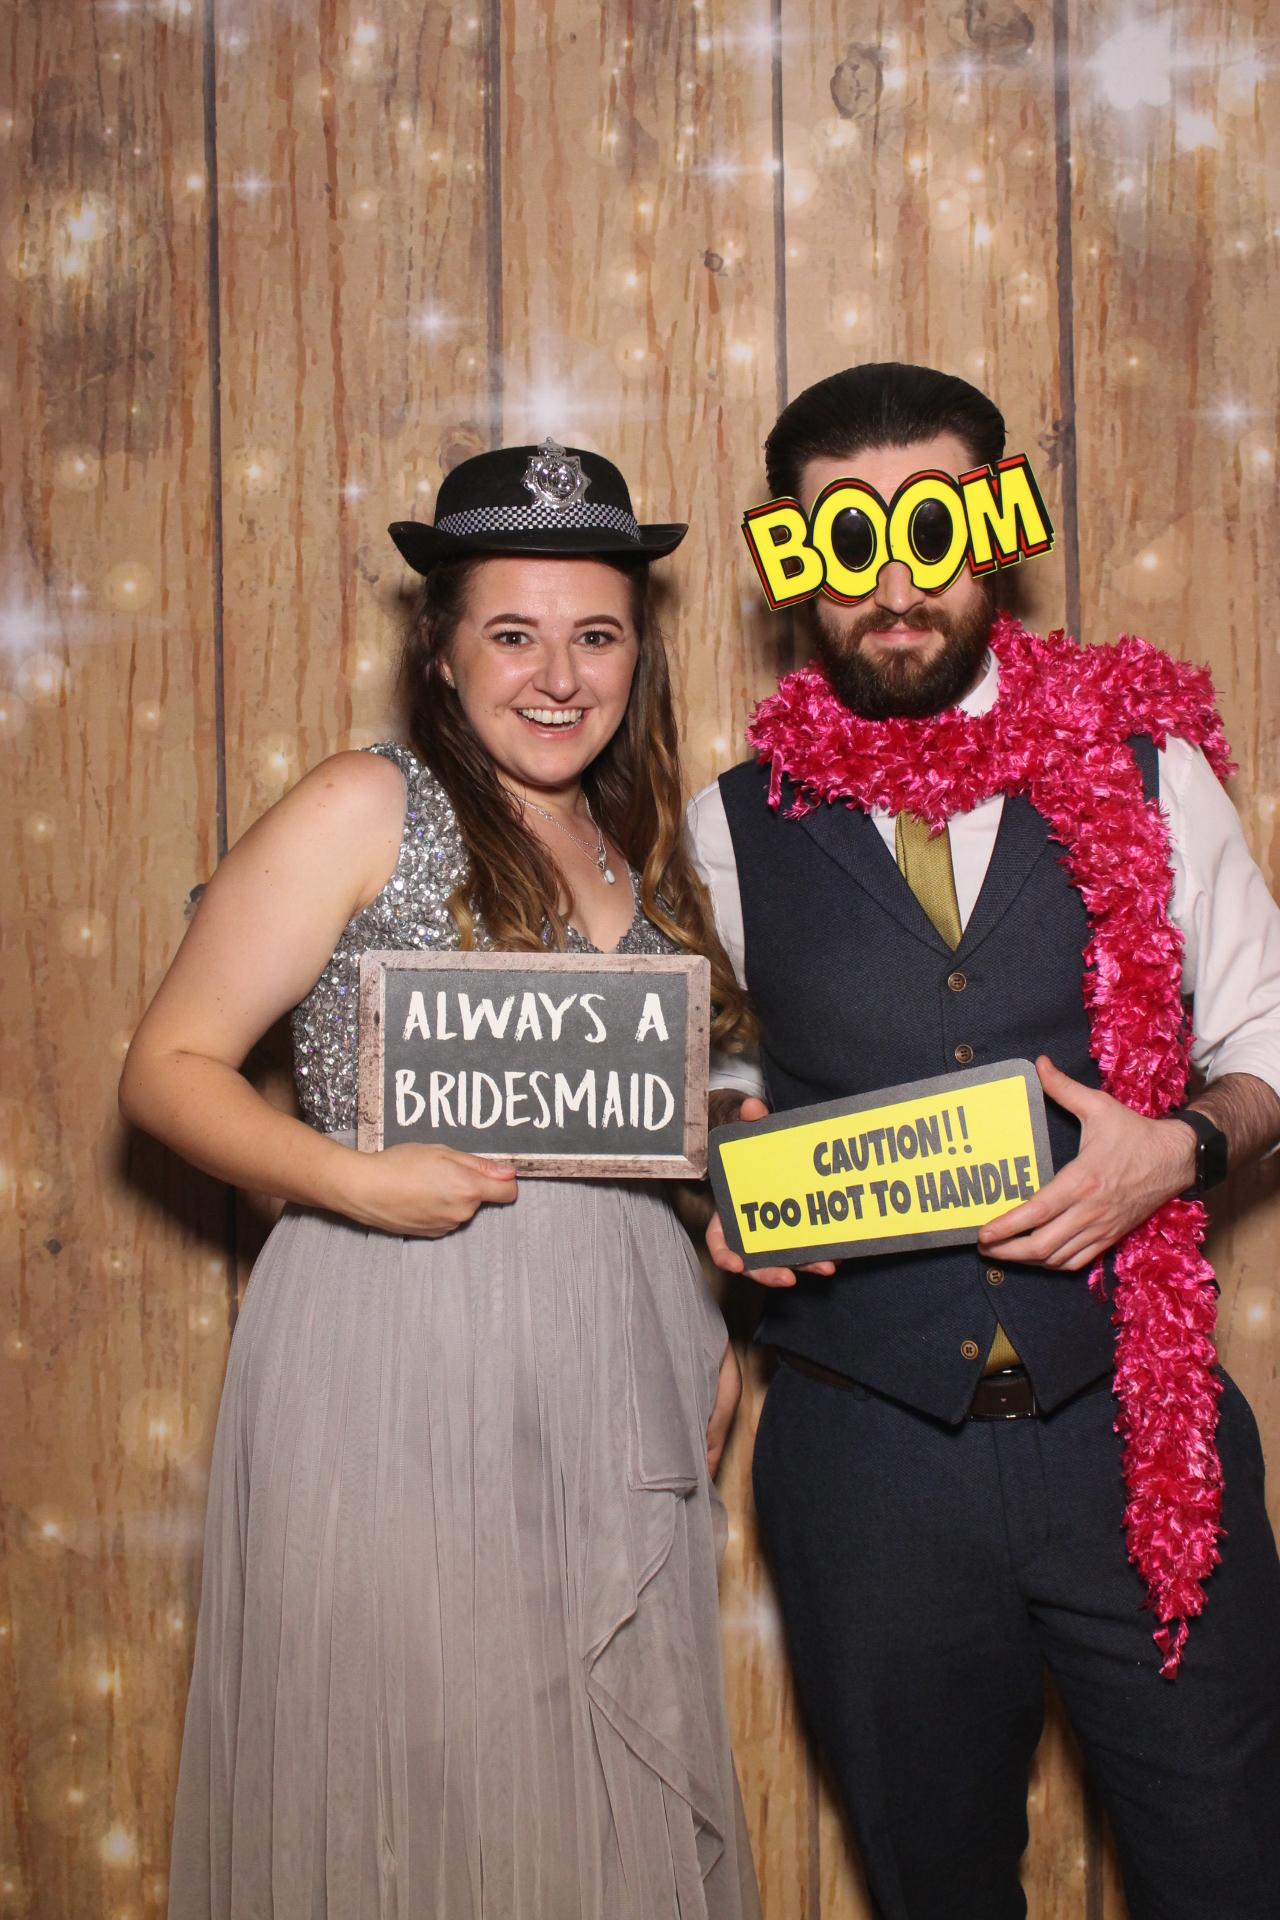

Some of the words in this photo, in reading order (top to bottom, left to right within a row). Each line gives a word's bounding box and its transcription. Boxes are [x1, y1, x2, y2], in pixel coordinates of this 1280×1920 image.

[743, 454, 1054, 610] BOOM
[402, 991, 607, 1043] ALWAYS
[635, 993, 670, 1042] A
[395, 1069, 675, 1131] BRIDESMAID
[813, 1105, 973, 1177] CAUTION!!
[741, 1198, 802, 1232] TOO
[806, 1183, 865, 1226] HOT
[870, 1178, 912, 1217] TO
[915, 1155, 1035, 1213] HANDLE
